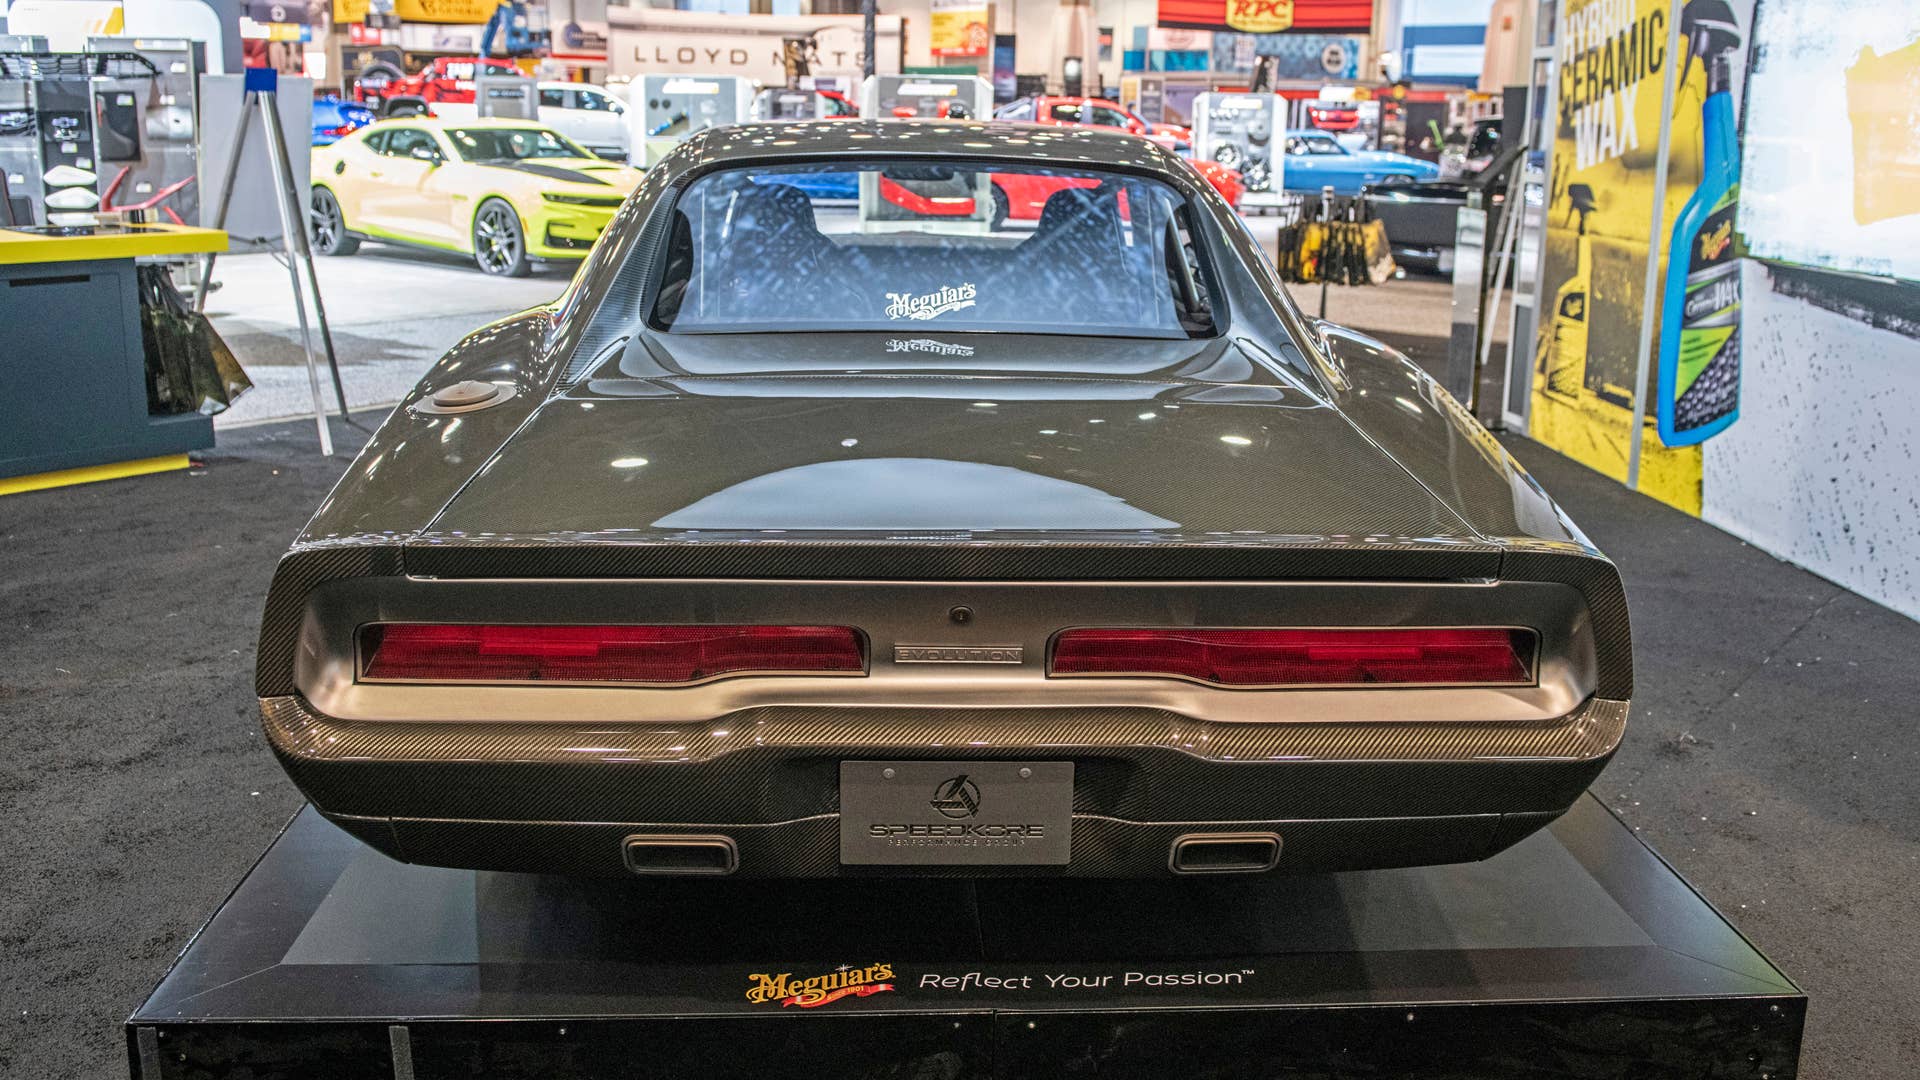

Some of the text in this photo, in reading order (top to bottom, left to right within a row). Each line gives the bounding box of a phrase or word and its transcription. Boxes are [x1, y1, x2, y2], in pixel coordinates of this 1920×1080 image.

[1234, 0, 1288, 18] RPC
[1562, 0, 1637, 64] HYBRID
[634, 46, 748, 64] LLOYD
[1559, 9, 1664, 111] CERAMIC
[1574, 74, 1639, 171] WAX
[885, 282, 976, 320] Meguiar's
[899, 649, 1019, 661] EVOLUTION
[869, 824, 1045, 838] SPEEDKORE
[888, 839, 1026, 847] PERFORMANCE GROUP
[746, 962, 895, 1004] Meguiar's
[919, 972, 1032, 991] Reflect
[1045, 974, 1113, 988] Your
